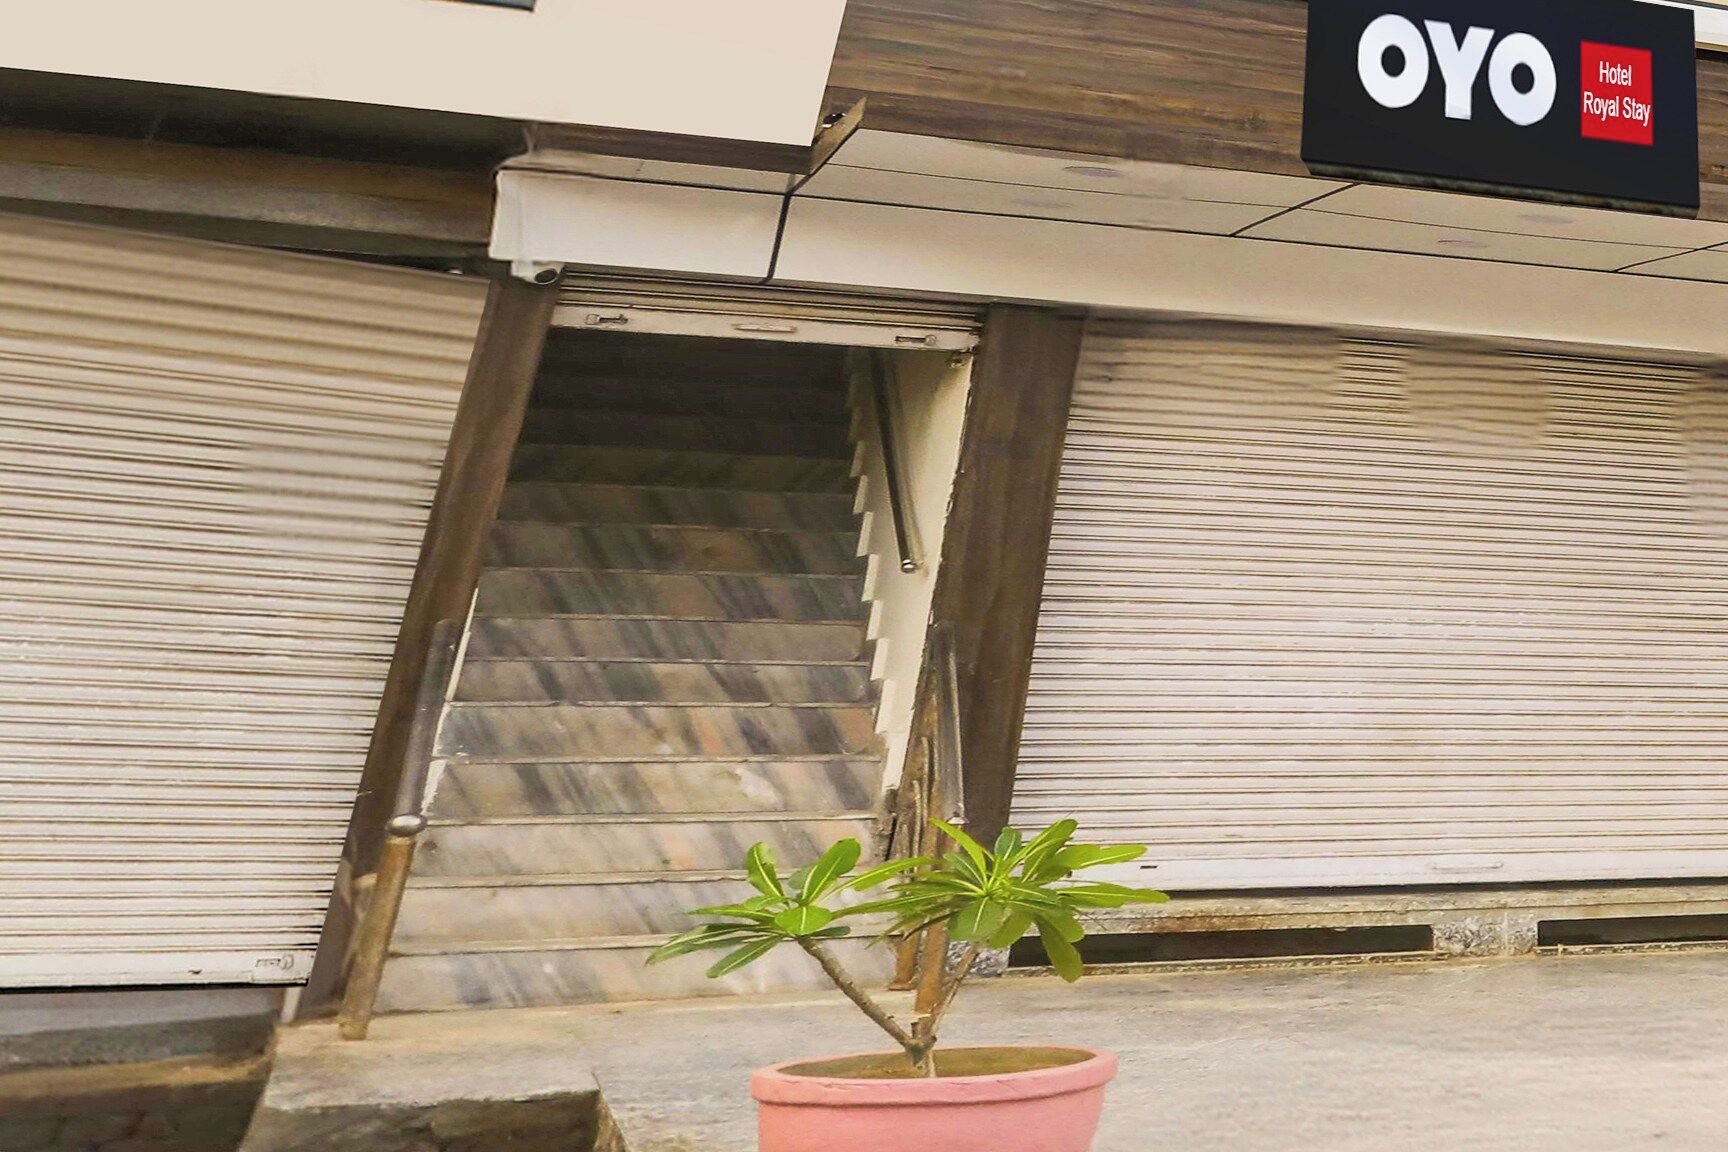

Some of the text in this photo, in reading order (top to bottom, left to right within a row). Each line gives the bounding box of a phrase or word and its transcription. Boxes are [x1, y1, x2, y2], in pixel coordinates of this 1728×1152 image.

[1357, 12, 1558, 127] OYO
[1598, 60, 1633, 88] Hotel
[1583, 94, 1652, 128] Royal Stay
